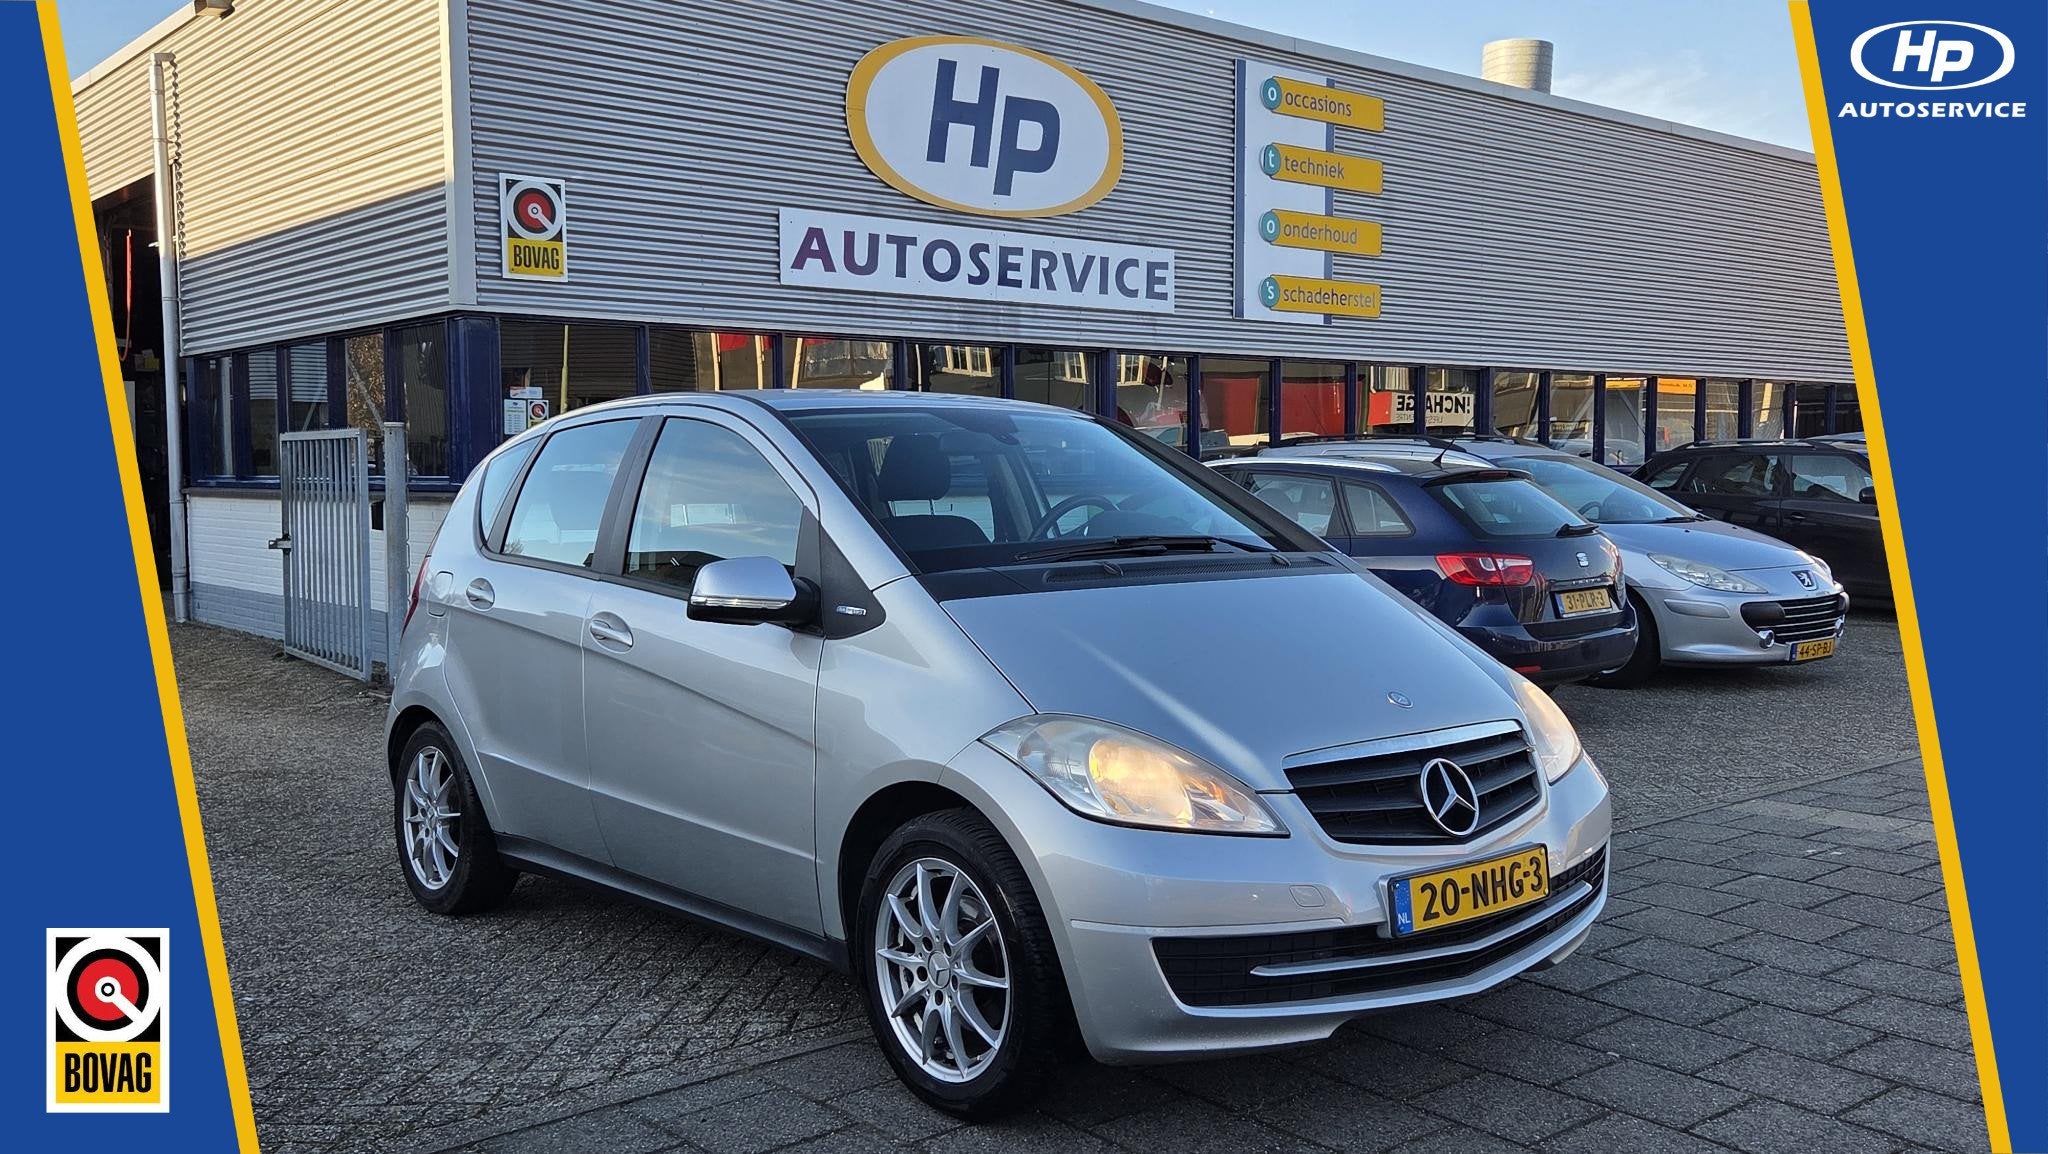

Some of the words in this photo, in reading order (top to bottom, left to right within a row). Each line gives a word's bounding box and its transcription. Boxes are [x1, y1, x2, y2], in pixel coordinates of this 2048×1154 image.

[1285, 91, 1352, 117] occasions
[926, 58, 1060, 196] Hp
[1284, 154, 1345, 179] techniek
[1283, 221, 1358, 245] onderhoud
[513, 244, 560, 270] BOVAG
[790, 226, 1169, 301] AUTOSERVICE
[1283, 285, 1376, 308] schadeherstel
[1566, 591, 1605, 610] 31-PLR-3
[1799, 641, 1832, 656] 44-SP-BJ
[1397, 912, 1412, 925] NL
[1420, 856, 1543, 922] 20-NHG-3
